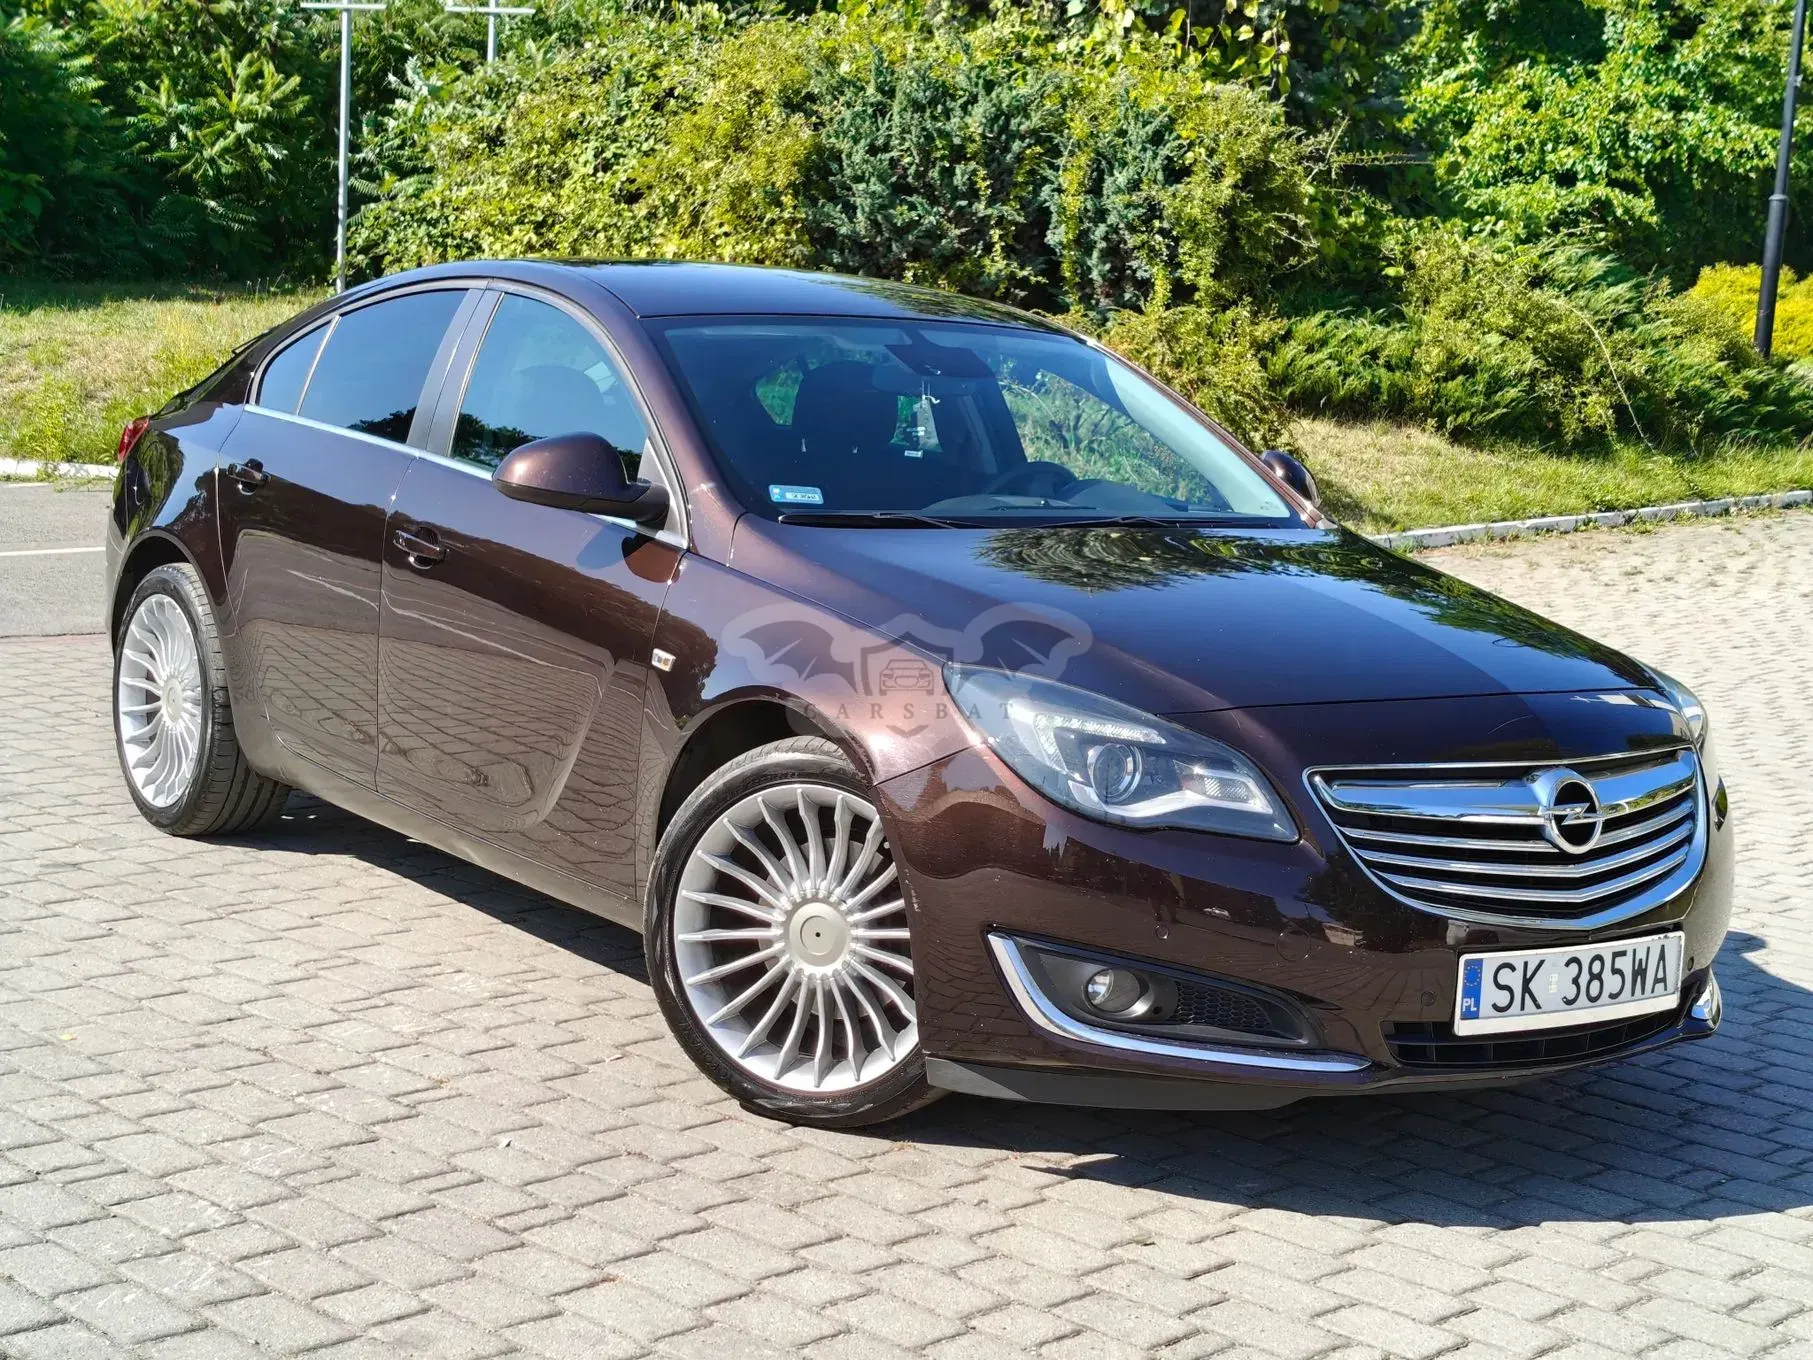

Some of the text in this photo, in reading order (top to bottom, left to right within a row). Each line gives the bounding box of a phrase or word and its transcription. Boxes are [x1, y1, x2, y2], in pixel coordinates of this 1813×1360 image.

[1491, 944, 1668, 1013] SK 385WA
[1462, 998, 1478, 1012] PL
